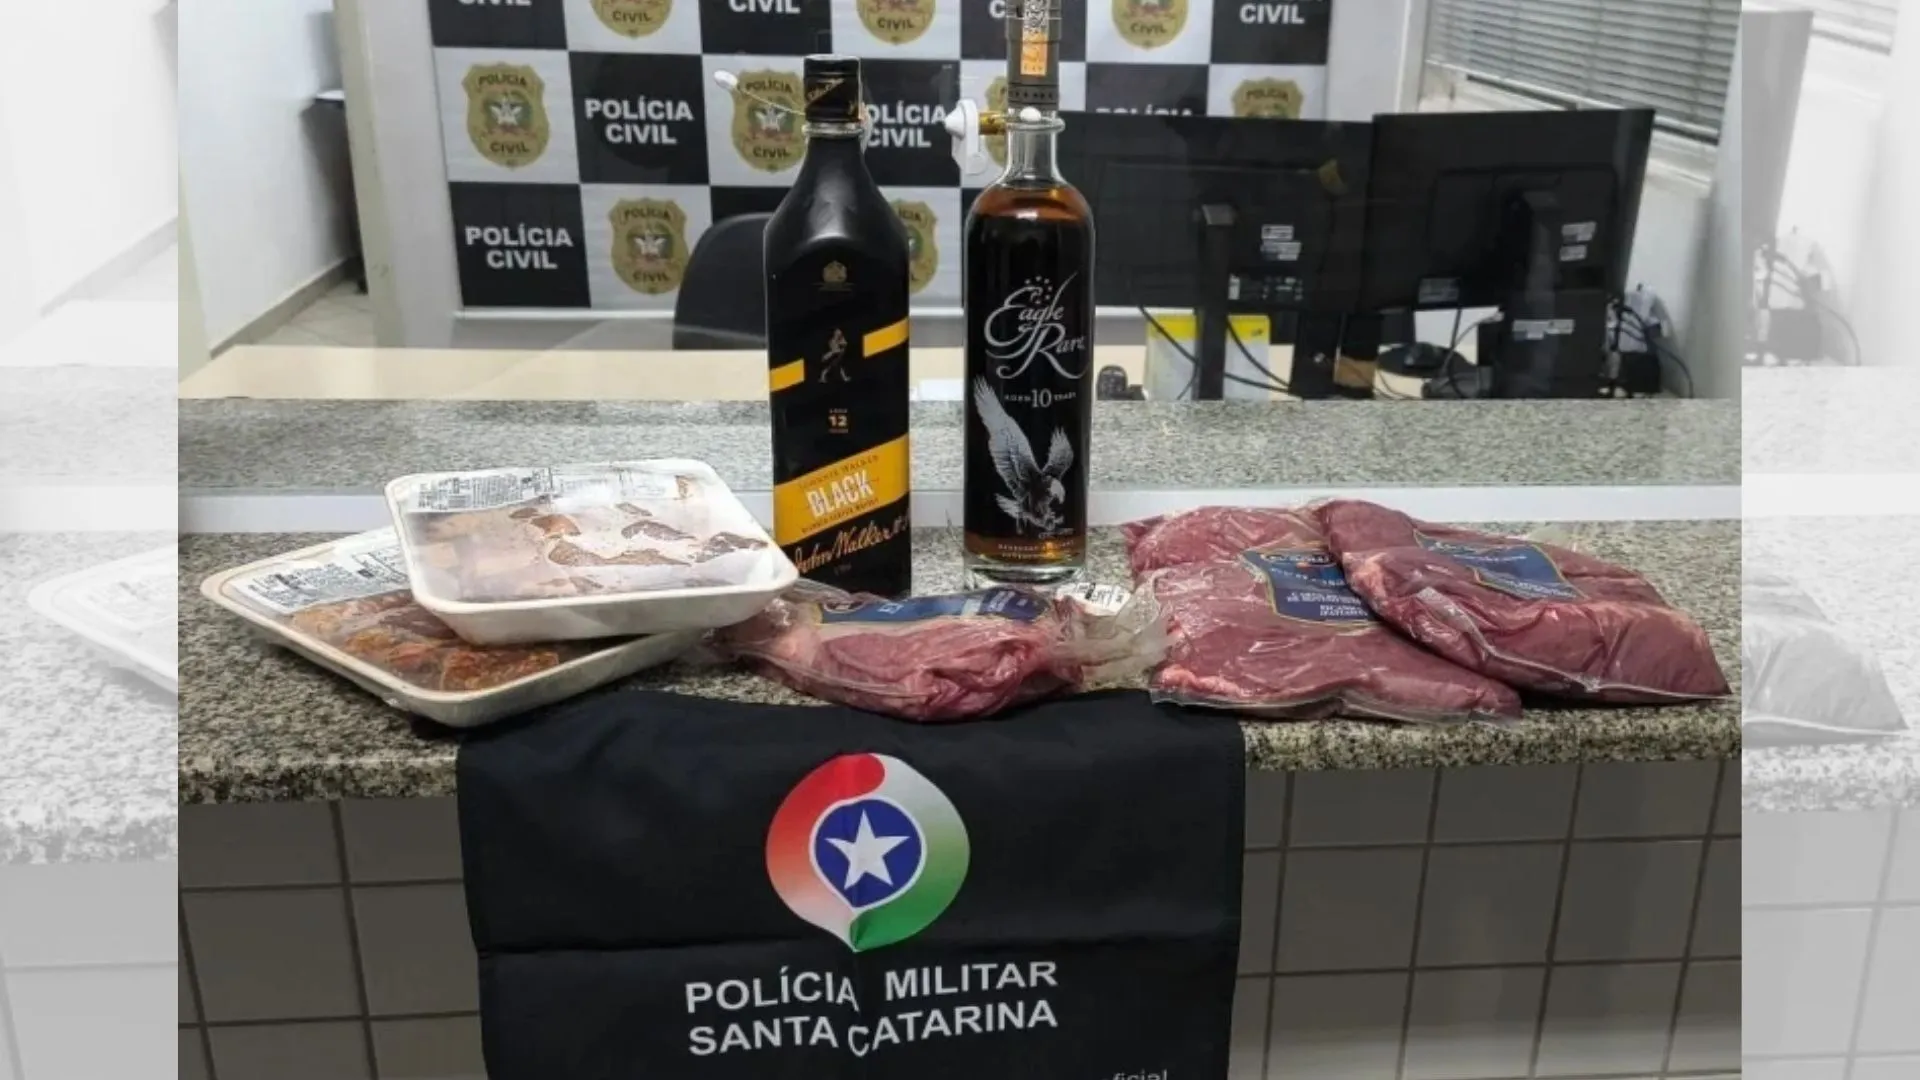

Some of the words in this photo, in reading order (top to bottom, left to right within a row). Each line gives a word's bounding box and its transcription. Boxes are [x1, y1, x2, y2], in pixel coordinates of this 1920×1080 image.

[612, 10, 651, 22] CIVIL
[729, 0, 800, 14] CIVIL
[1240, 4, 1305, 24] CIVIL
[877, 17, 914, 29] CIVIL
[1130, 22, 1167, 34] CIVIL
[584, 95, 693, 121] POLÍCIA
[866, 100, 948, 126] OLÍCIA
[605, 123, 677, 144] CIVIL
[490, 141, 530, 155] CIVIL
[752, 147, 791, 159] CIVIL
[465, 222, 573, 247] POLÍCIA
[486, 250, 557, 270] CIVIL
[632, 271, 670, 283] CIVIL
[984, 271, 1078, 359] Eagle
[996, 322, 1089, 379] Rare
[1031, 388, 1052, 408] 10
[828, 415, 848, 427] 12
[806, 469, 874, 518] BLACK
[685, 965, 859, 1013] POLÍCIA
[885, 961, 1058, 1001] MILITAR
[689, 1015, 839, 1056] SANTA
[848, 999, 1059, 1057] CATARINA
